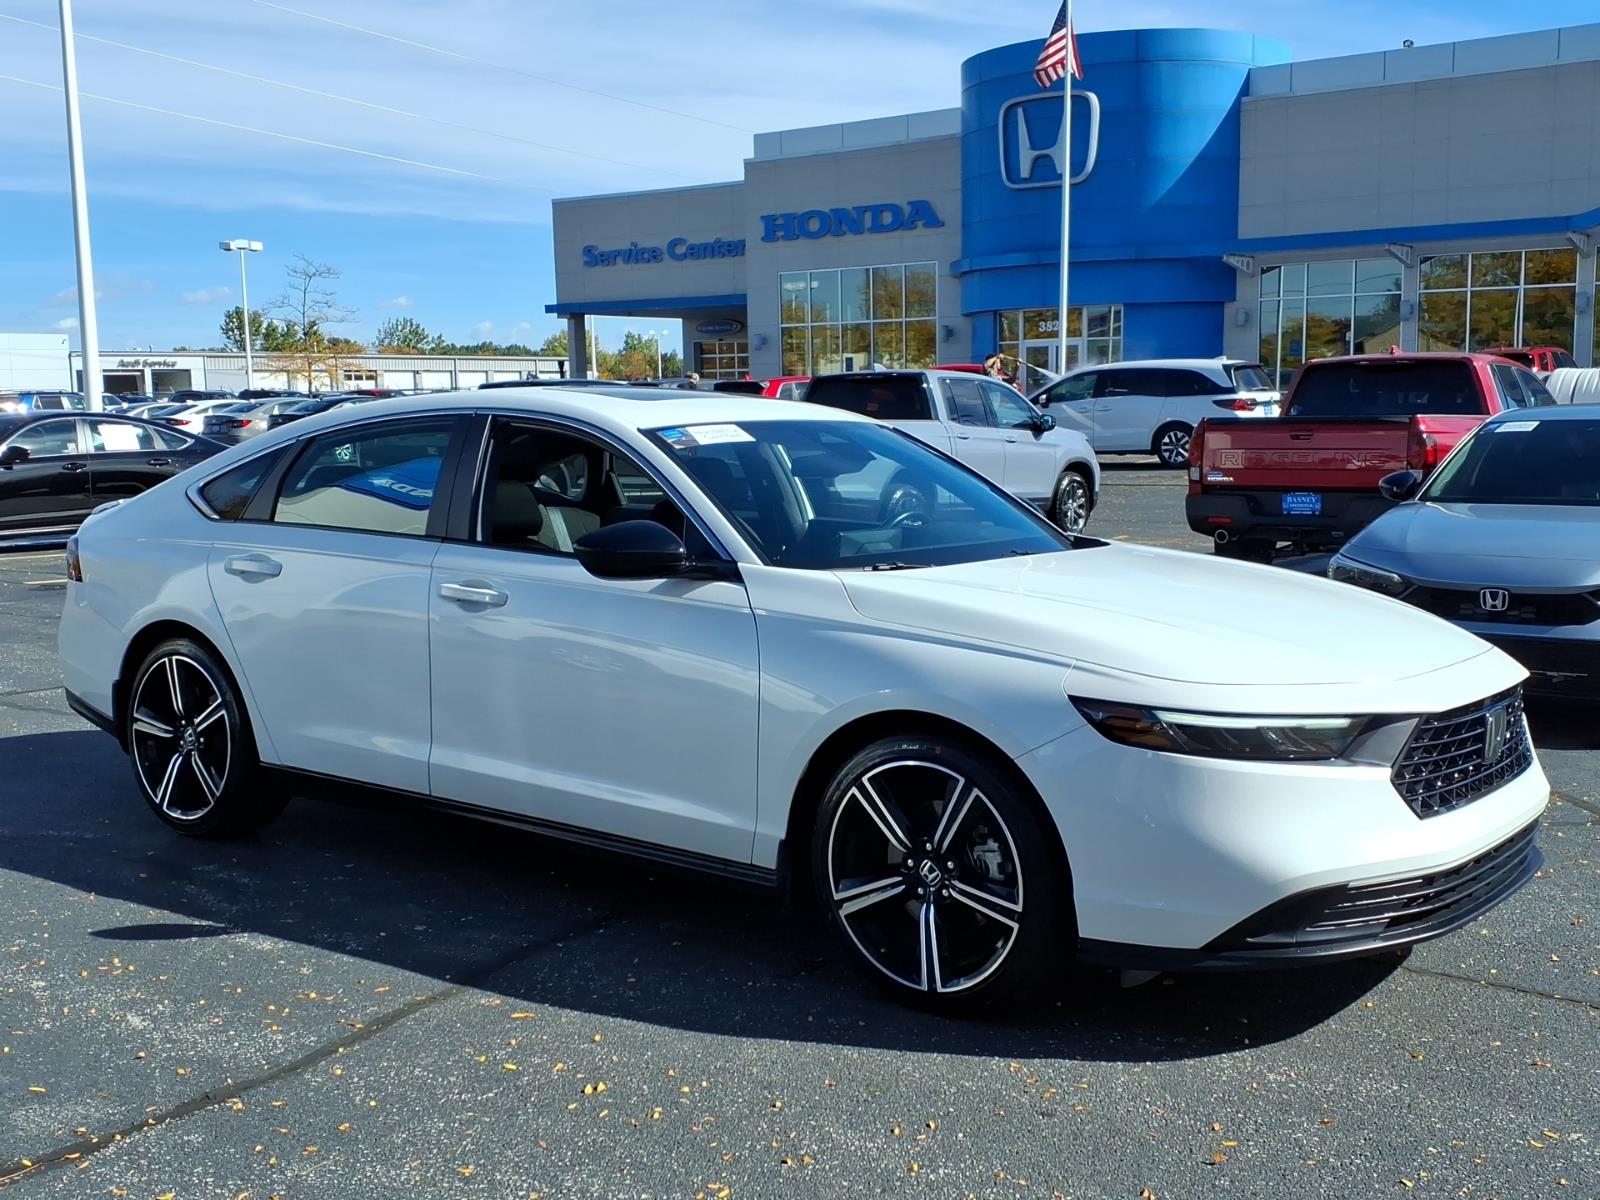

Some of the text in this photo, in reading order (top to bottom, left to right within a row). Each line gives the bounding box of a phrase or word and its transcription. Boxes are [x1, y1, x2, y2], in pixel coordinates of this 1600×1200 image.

[760, 200, 945, 242] HONDA
[582, 237, 746, 267] Service Center
